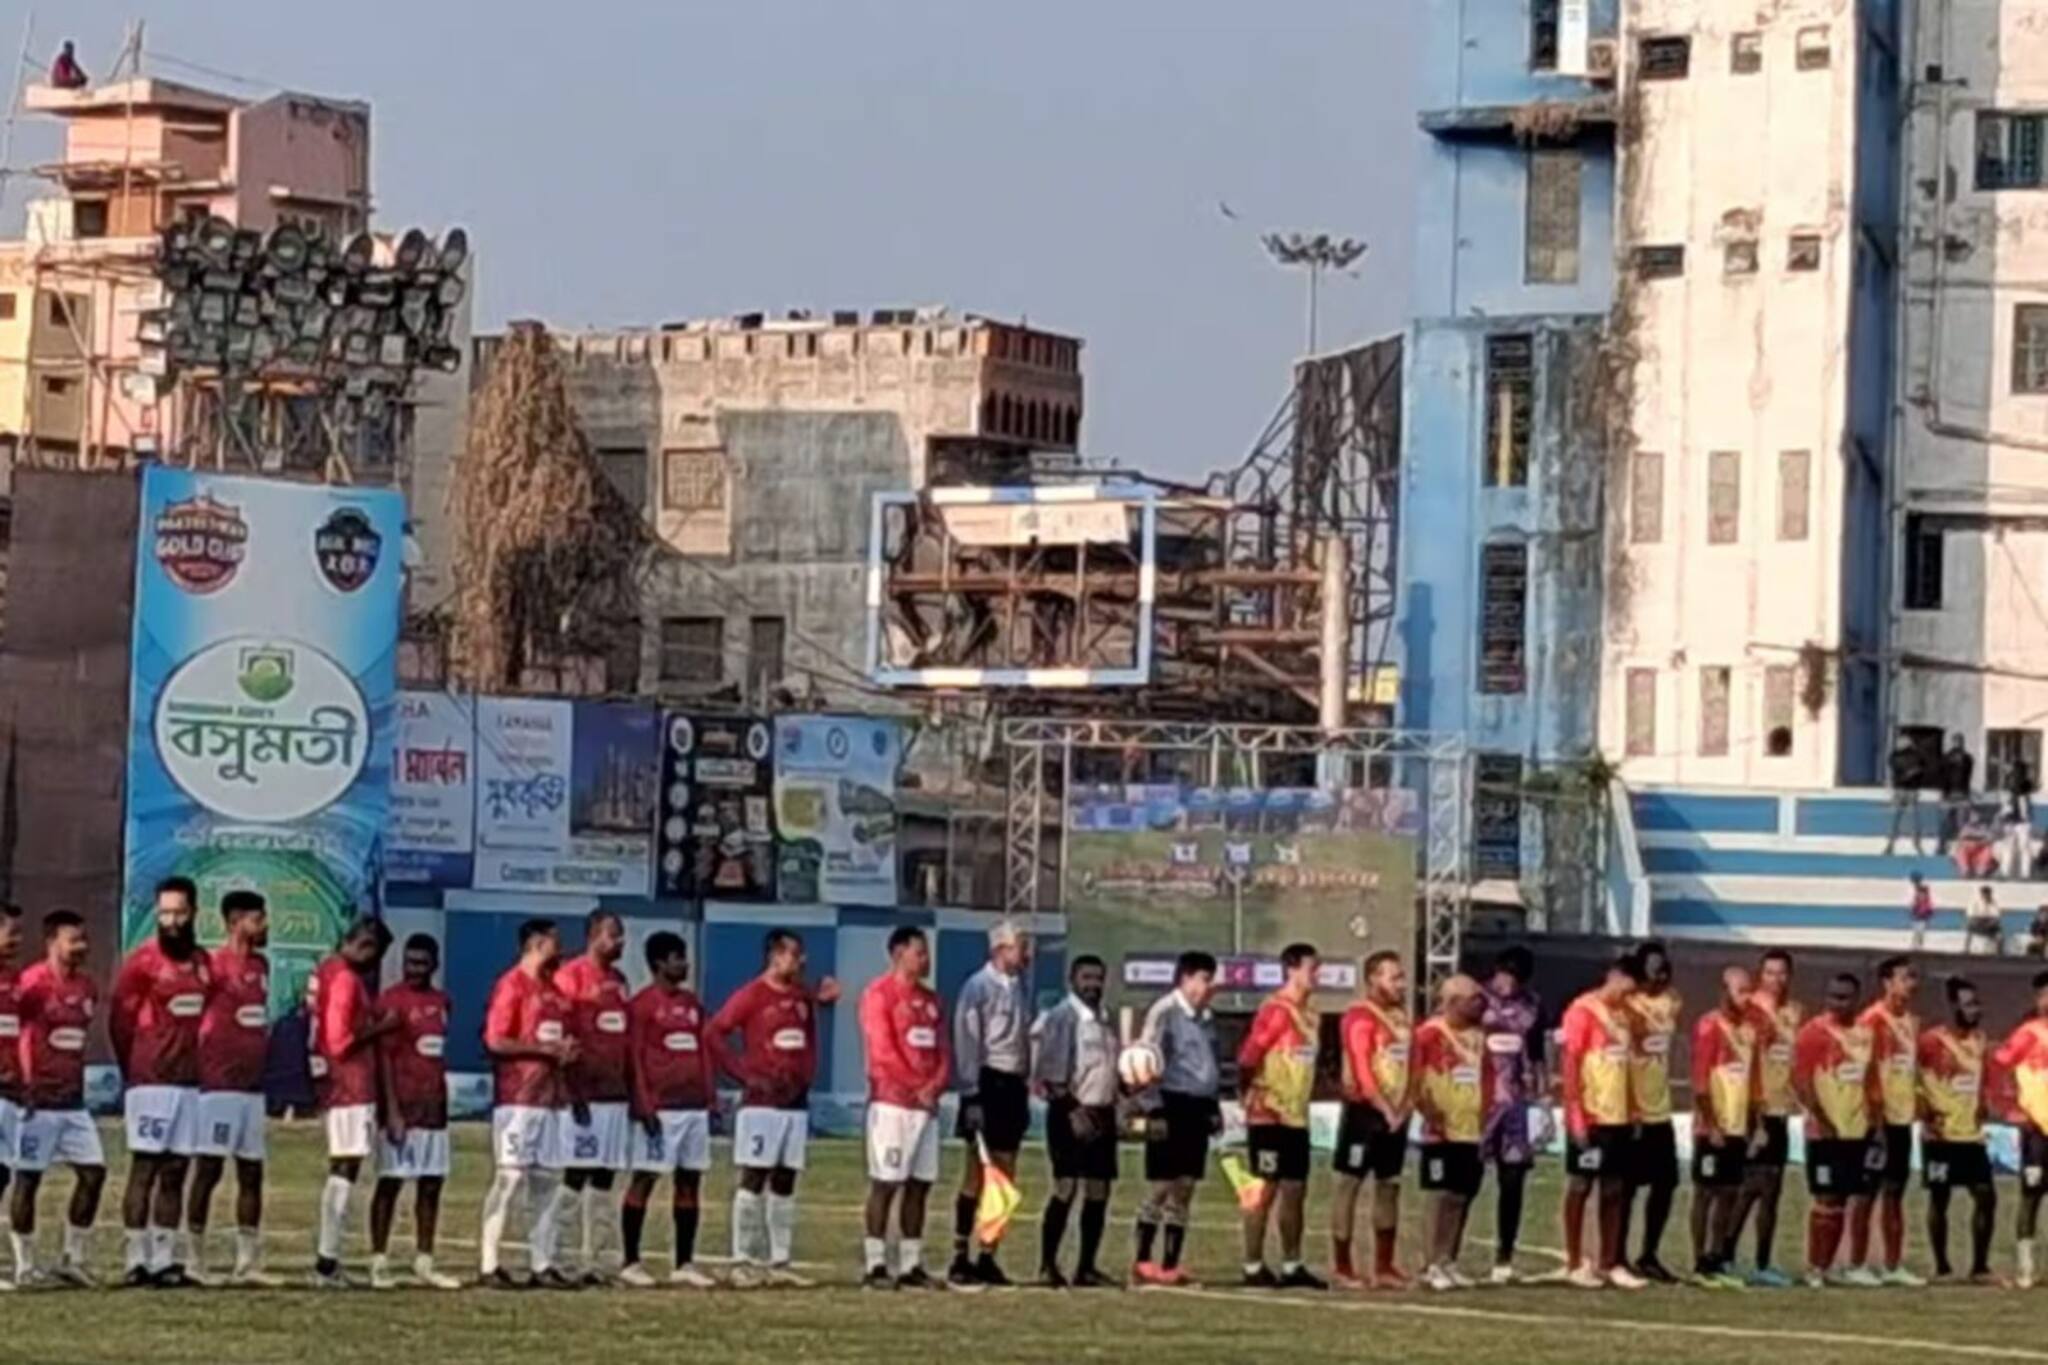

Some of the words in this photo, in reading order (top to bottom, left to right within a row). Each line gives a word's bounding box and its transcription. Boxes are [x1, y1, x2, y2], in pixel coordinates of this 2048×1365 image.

[155, 535, 205, 557] GOLD
[168, 705, 357, 785] বসুমতী
[138, 1115, 164, 1139] 26
[751, 1134, 765, 1157] 3
